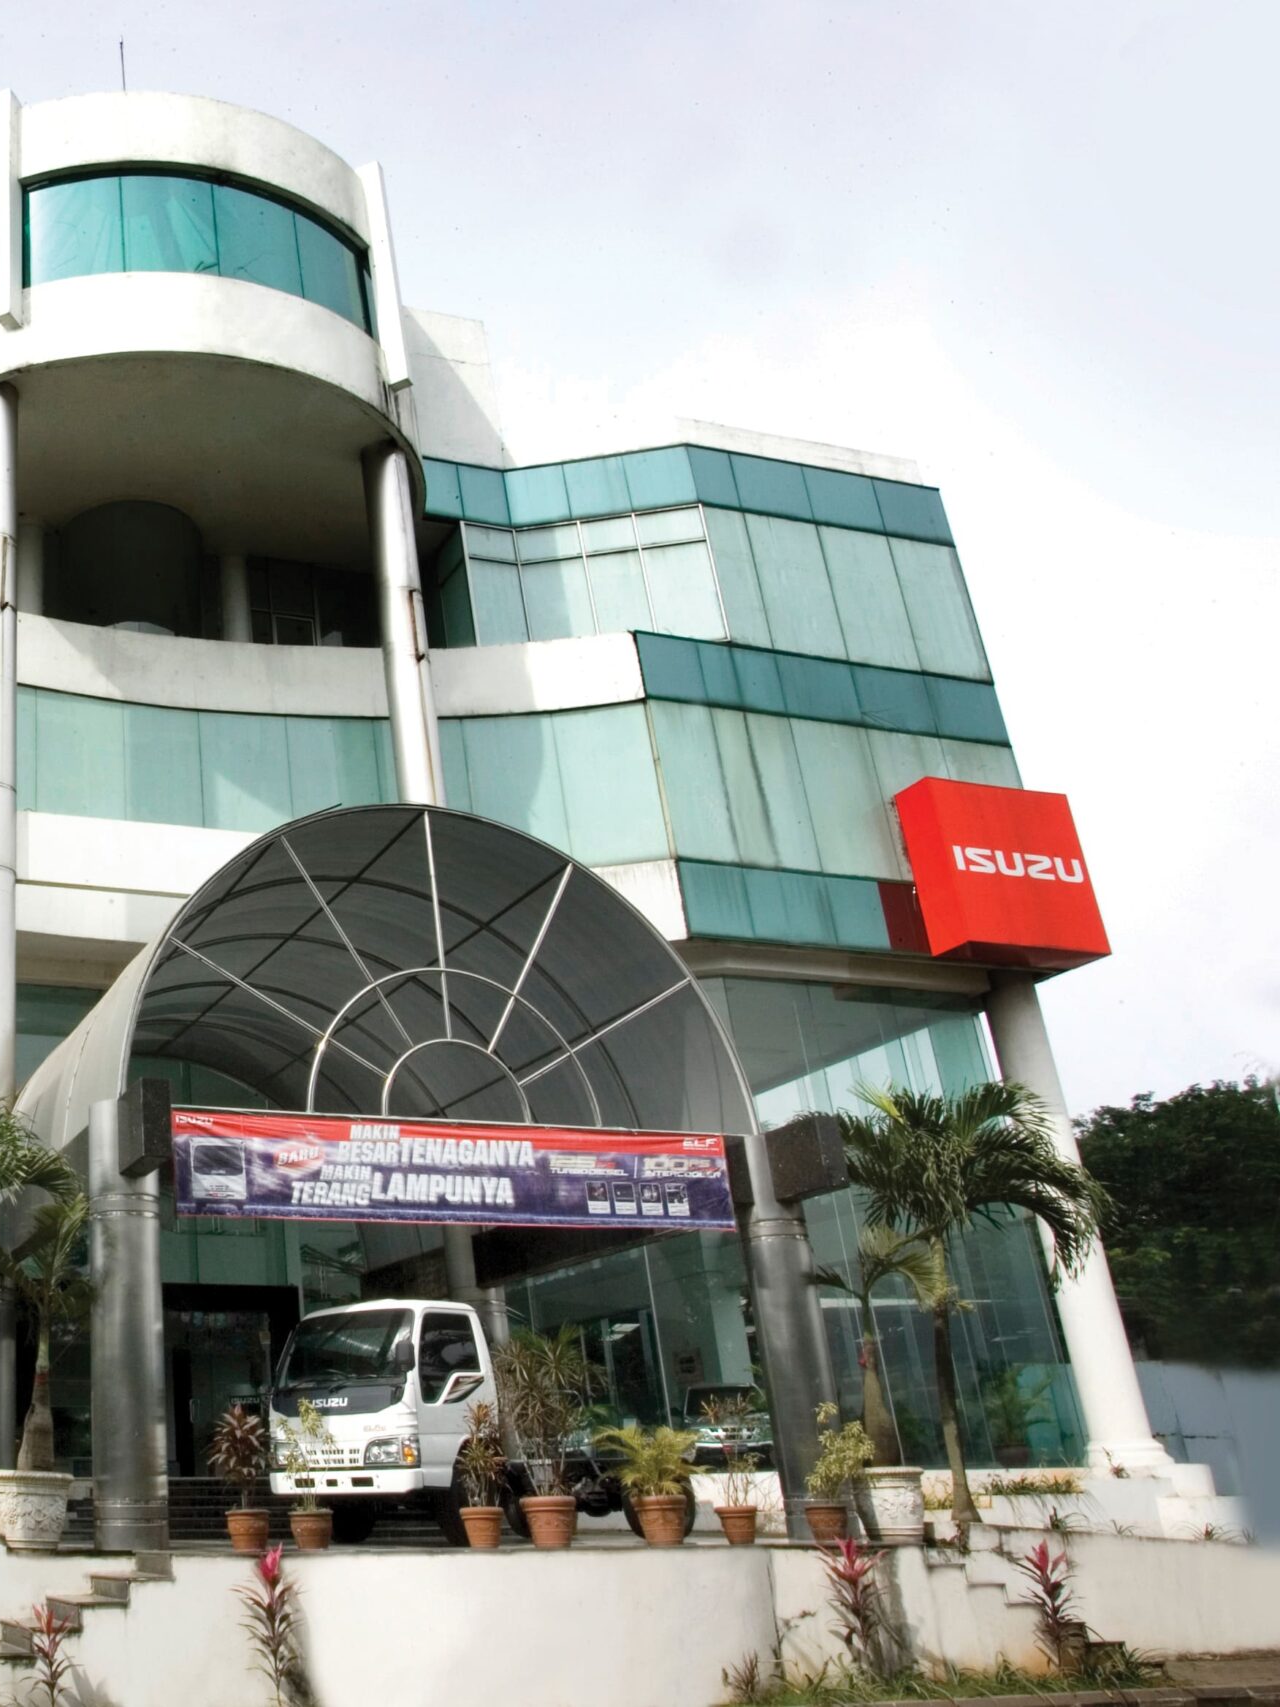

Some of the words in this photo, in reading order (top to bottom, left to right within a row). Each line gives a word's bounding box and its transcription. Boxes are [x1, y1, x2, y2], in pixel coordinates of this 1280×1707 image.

[952, 845, 1085, 884] ISUZU
[349, 1124, 401, 1140] MAKIN
[682, 1136, 718, 1148] ELF
[277, 1147, 320, 1166] BARU
[338, 1140, 401, 1164] BESAR
[400, 1137, 535, 1167] TENAGANYA
[320, 1164, 372, 1181] MAKIN
[291, 1181, 371, 1207] TERANG
[371, 1171, 516, 1208] LAMPUNYA
[312, 1397, 349, 1408] ISUZU
